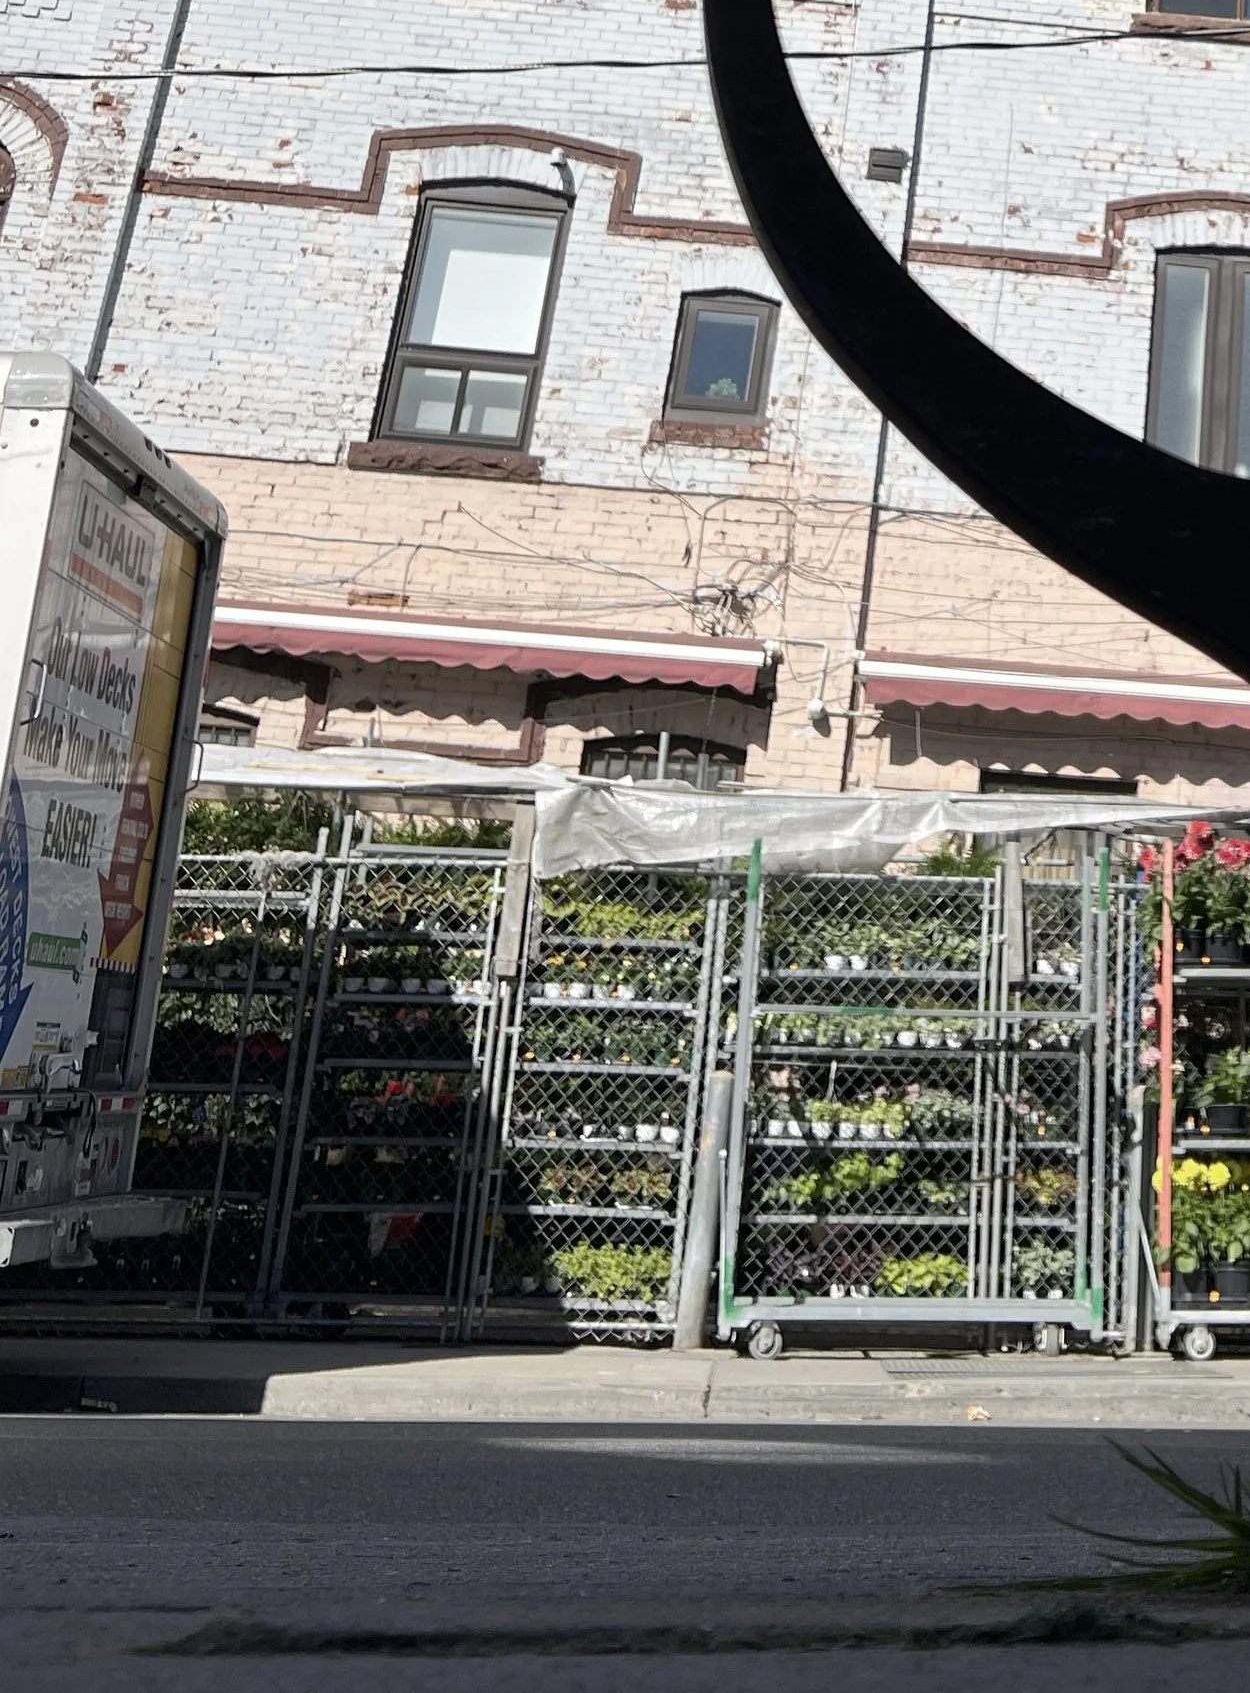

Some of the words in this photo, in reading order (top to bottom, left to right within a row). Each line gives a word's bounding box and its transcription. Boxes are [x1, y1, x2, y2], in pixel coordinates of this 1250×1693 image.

[79, 495, 146, 588] U-HAUL
[47, 616, 71, 682] Our
[70, 630, 98, 696] Low
[96, 647, 136, 715] Decks
[23, 696, 63, 768] Make
[65, 714, 94, 780] Your
[92, 728, 128, 793] Move
[41, 799, 97, 869] EASIER!
[8, 887, 24, 1005] DECKS
[31, 937, 80, 966] uhaul.com
